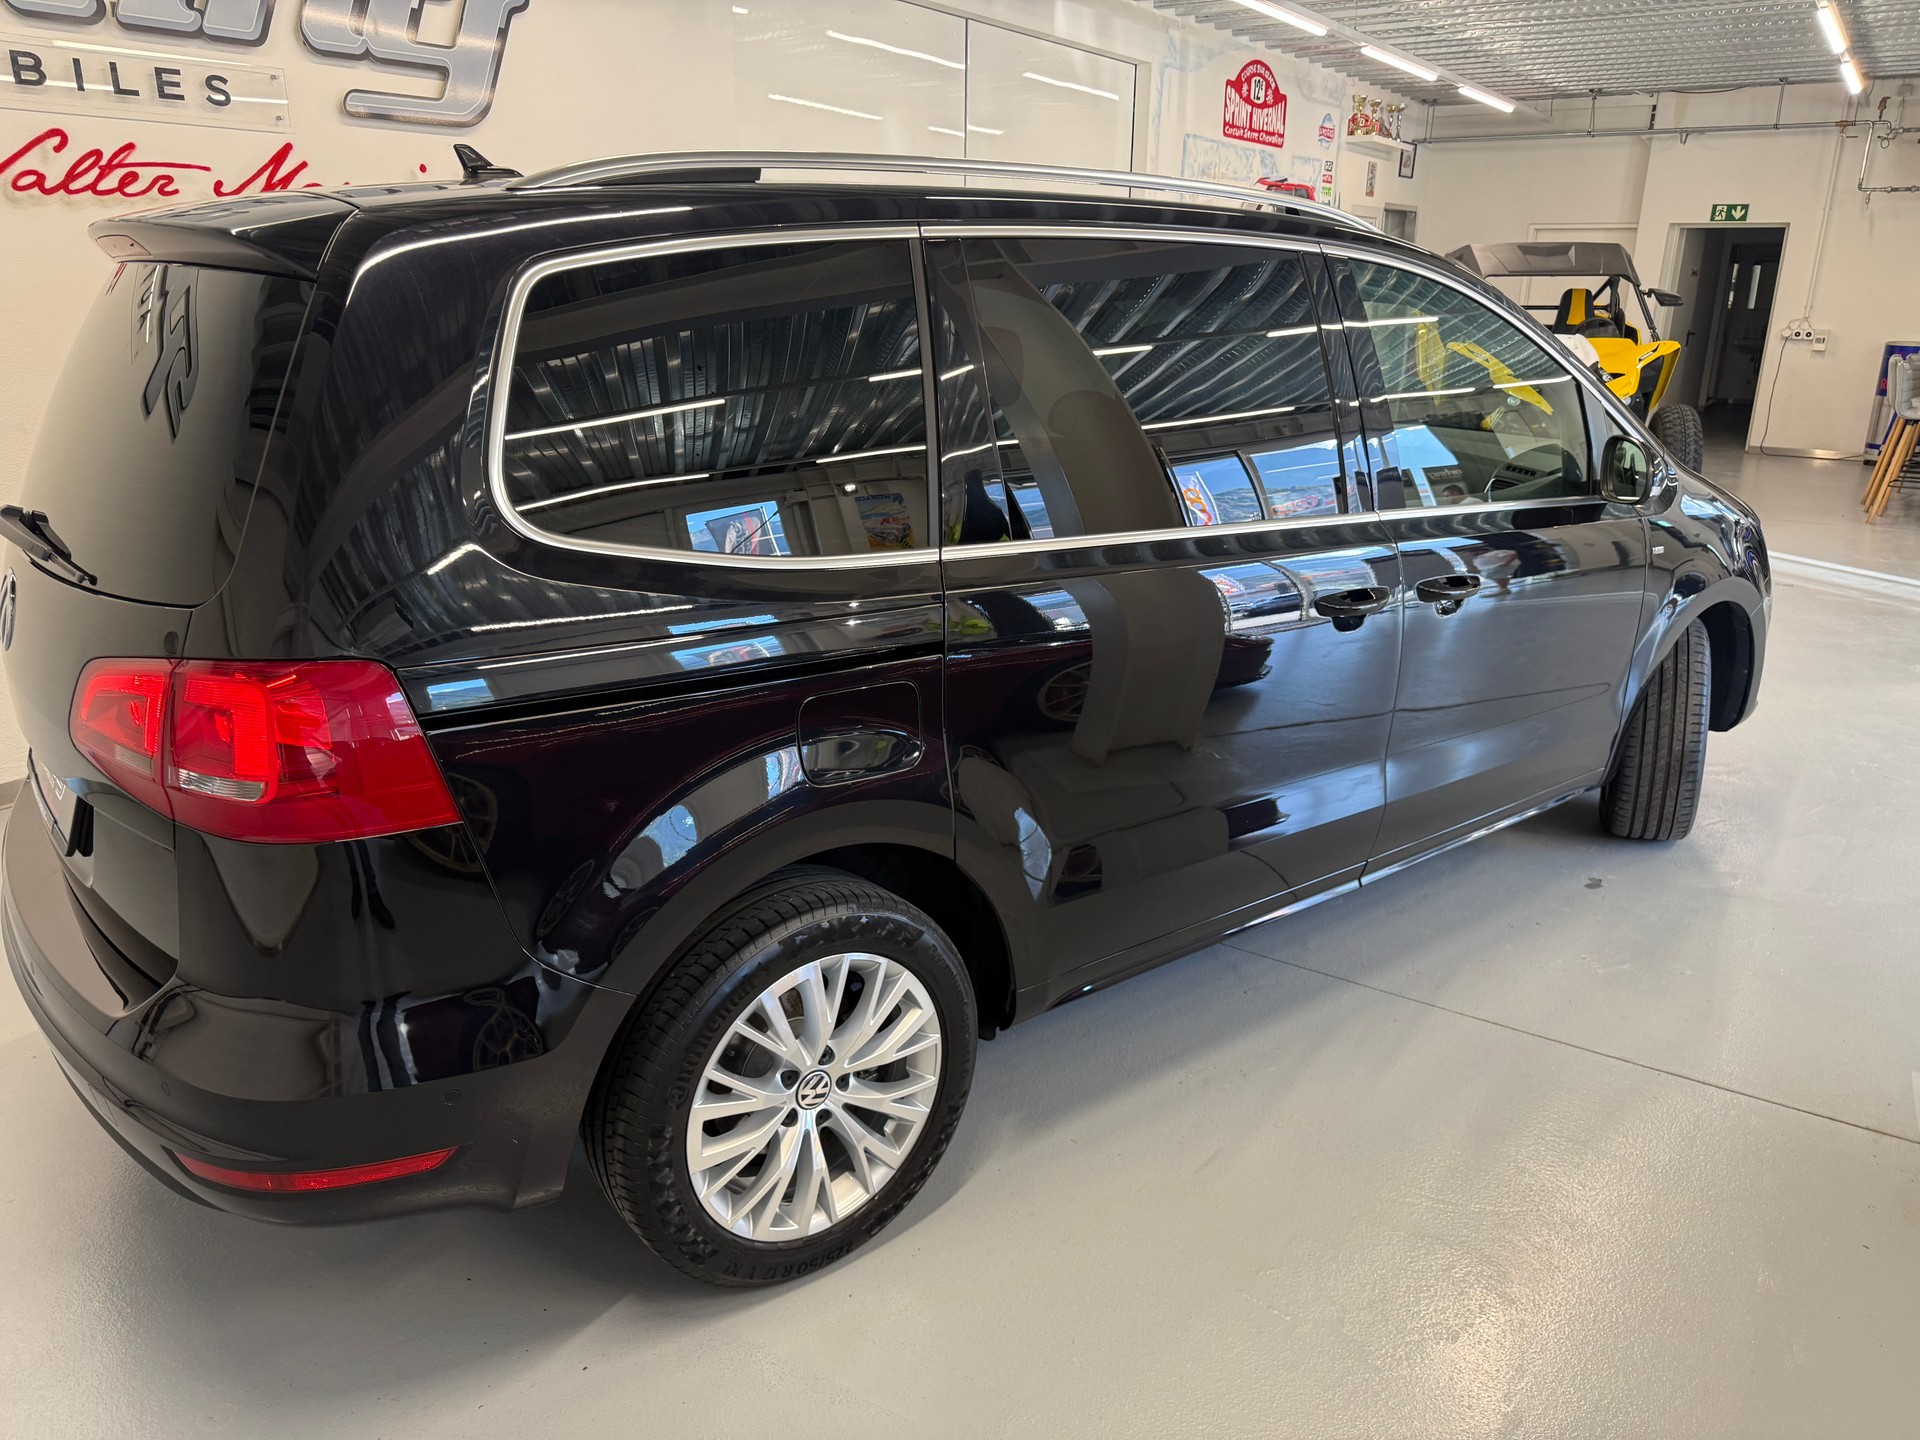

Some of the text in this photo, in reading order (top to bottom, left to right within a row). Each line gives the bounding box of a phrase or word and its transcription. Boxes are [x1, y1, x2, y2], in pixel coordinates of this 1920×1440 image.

[9, 49, 232, 107] BILES
[1225, 84, 1285, 135] SPRINT HIVERNAL
[1225, 125, 1284, 145] Circuit Serre Chevalier
